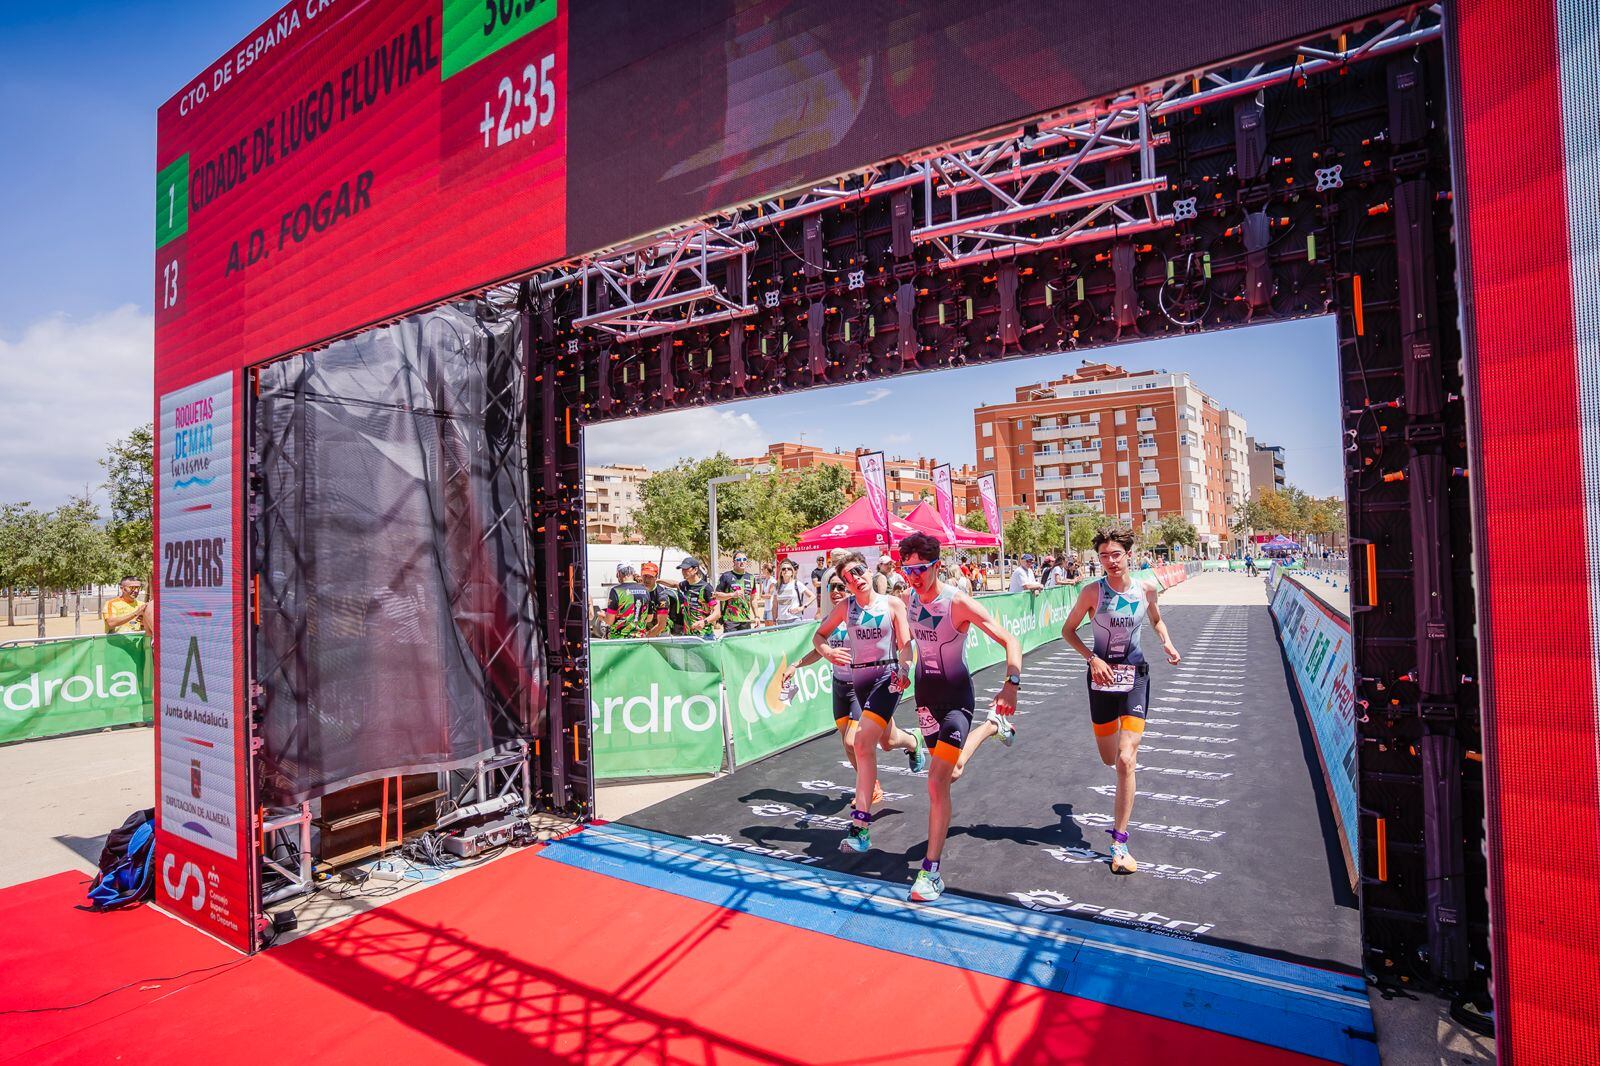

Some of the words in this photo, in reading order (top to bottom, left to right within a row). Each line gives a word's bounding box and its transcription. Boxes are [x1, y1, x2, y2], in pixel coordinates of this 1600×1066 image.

[180, 82, 210, 116] CTO.
[213, 60, 232, 92] DE
[236, 9, 301, 74] ESPAÑA
[480, 53, 555, 148] +2:35
[169, 183, 175, 228] 1
[191, 137, 248, 212] CIDADE
[252, 118, 275, 175] DE
[280, 81, 334, 159] LUGO
[340, 15, 438, 121] FLUVIAL
[225, 228, 269, 277] A.D.
[278, 169, 374, 251] FOGAR
[164, 260, 179, 309] 13
[175, 396, 213, 429] ROQUETAS
[175, 429, 188, 459] DE
[189, 423, 213, 452] MAR
[171, 454, 211, 478] turismo
[164, 537, 224, 588] 226ERS
[855, 627, 882, 640] IRADIER
[1110, 614, 1135, 628] MARTÍN
[0, 665, 138, 711] drola
[165, 704, 183, 718] Junta
[184, 709, 192, 721] de
[193, 710, 229, 729] Andalucía
[166, 795, 197, 815] DIPUTACIÓN
[197, 807, 205, 818] DE
[206, 810, 231, 827] ALMERÍA
[209, 889, 229, 905] Consejo
[210, 900, 230, 916] Superior
[217, 912, 239, 931] Deportes
[1067, 903, 1216, 934] Fetri
